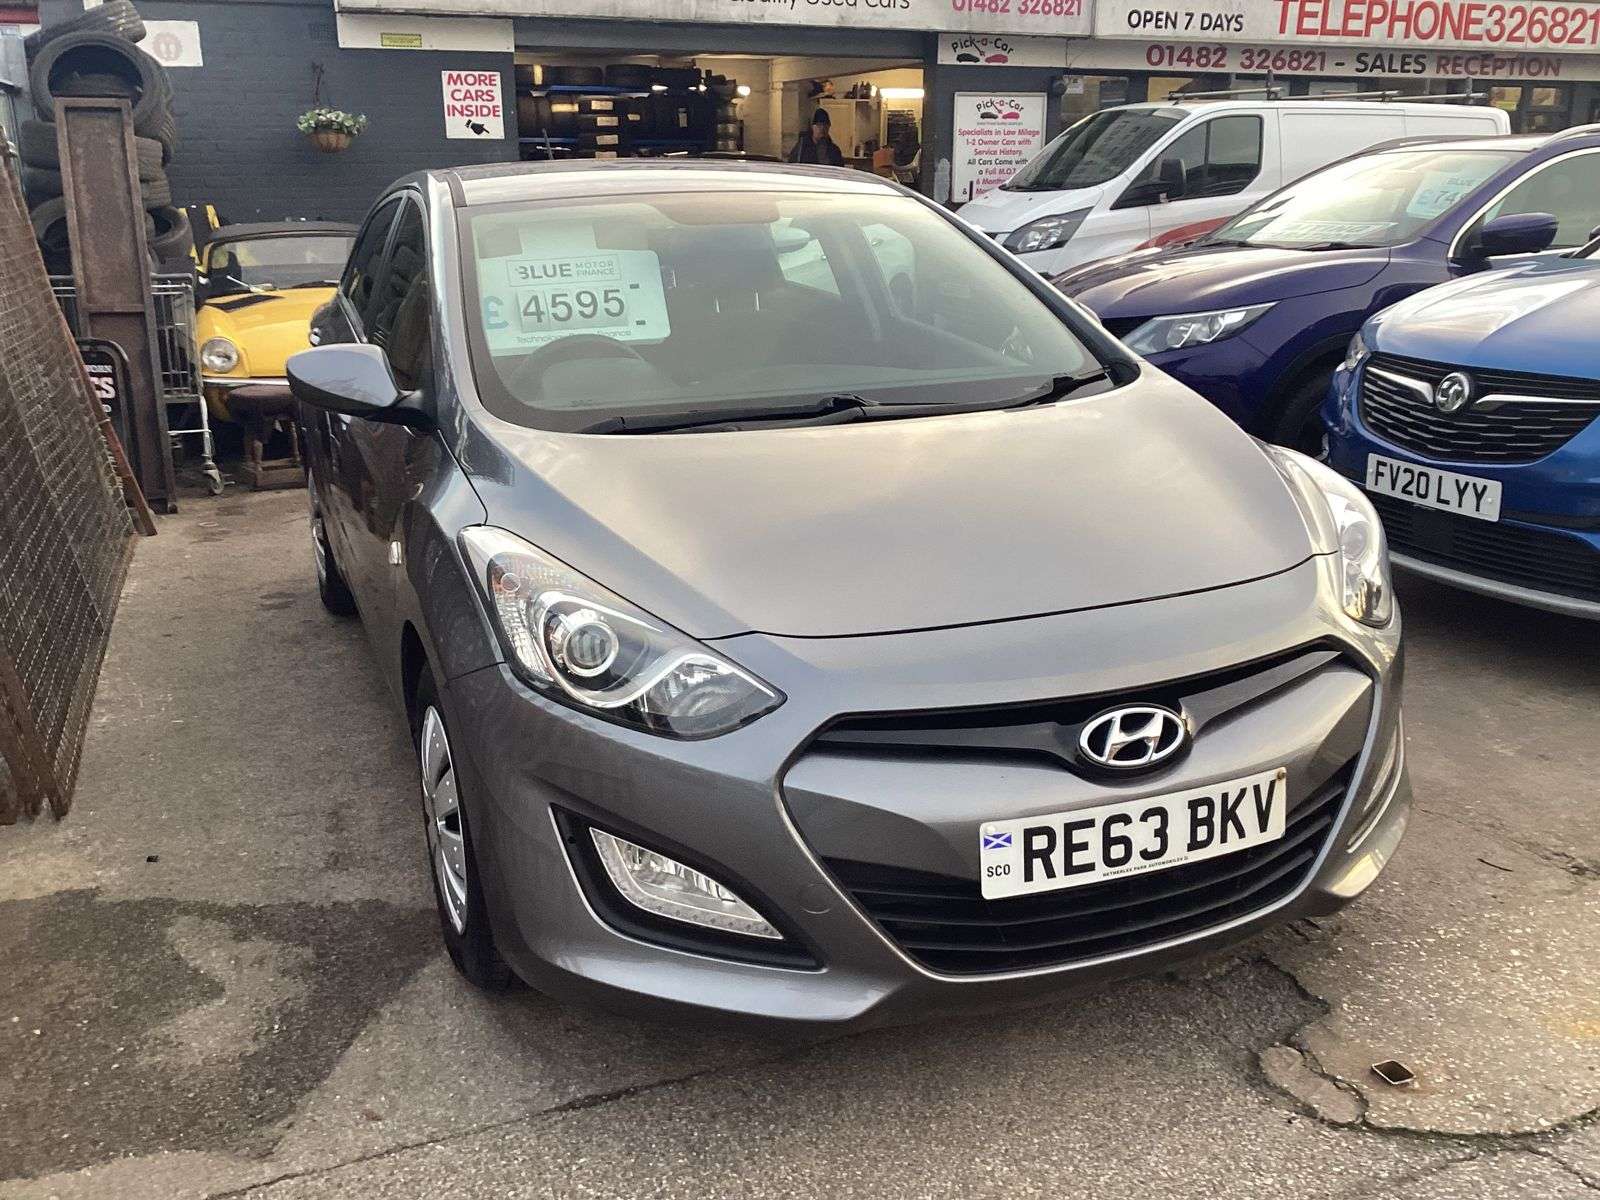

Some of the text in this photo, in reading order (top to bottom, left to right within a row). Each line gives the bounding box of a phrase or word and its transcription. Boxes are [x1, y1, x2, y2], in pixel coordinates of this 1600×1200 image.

[1017, 0, 1082, 16] 326821
[1127, 9, 1244, 32] OPEN 7 DAYS
[1146, 45, 1228, 68] 01482
[1239, 48, 1327, 72] 326821
[1355, 52, 1428, 75] SALES
[1435, 54, 1562, 77] RECEPTION
[447, 73, 498, 87] MORE
[450, 89, 496, 103] CARS
[446, 104, 501, 118] INSIDE
[958, 128, 993, 137] Specialists
[978, 138, 999, 146] Owner
[1001, 138, 1016, 146] Cars
[1018, 138, 1032, 146] with
[967, 158, 976, 166] All
[978, 158, 993, 166] Cars
[994, 158, 1013, 166] Come
[985, 167, 998, 175] Full
[516, 260, 614, 280] BLUE MOTOR
[576, 267, 616, 277] FINANCE
[523, 288, 626, 324] 4595
[1374, 459, 1488, 513] FV20 LYY
[1023, 779, 1278, 883] RE63 BKV
[986, 863, 1012, 878] SCO
